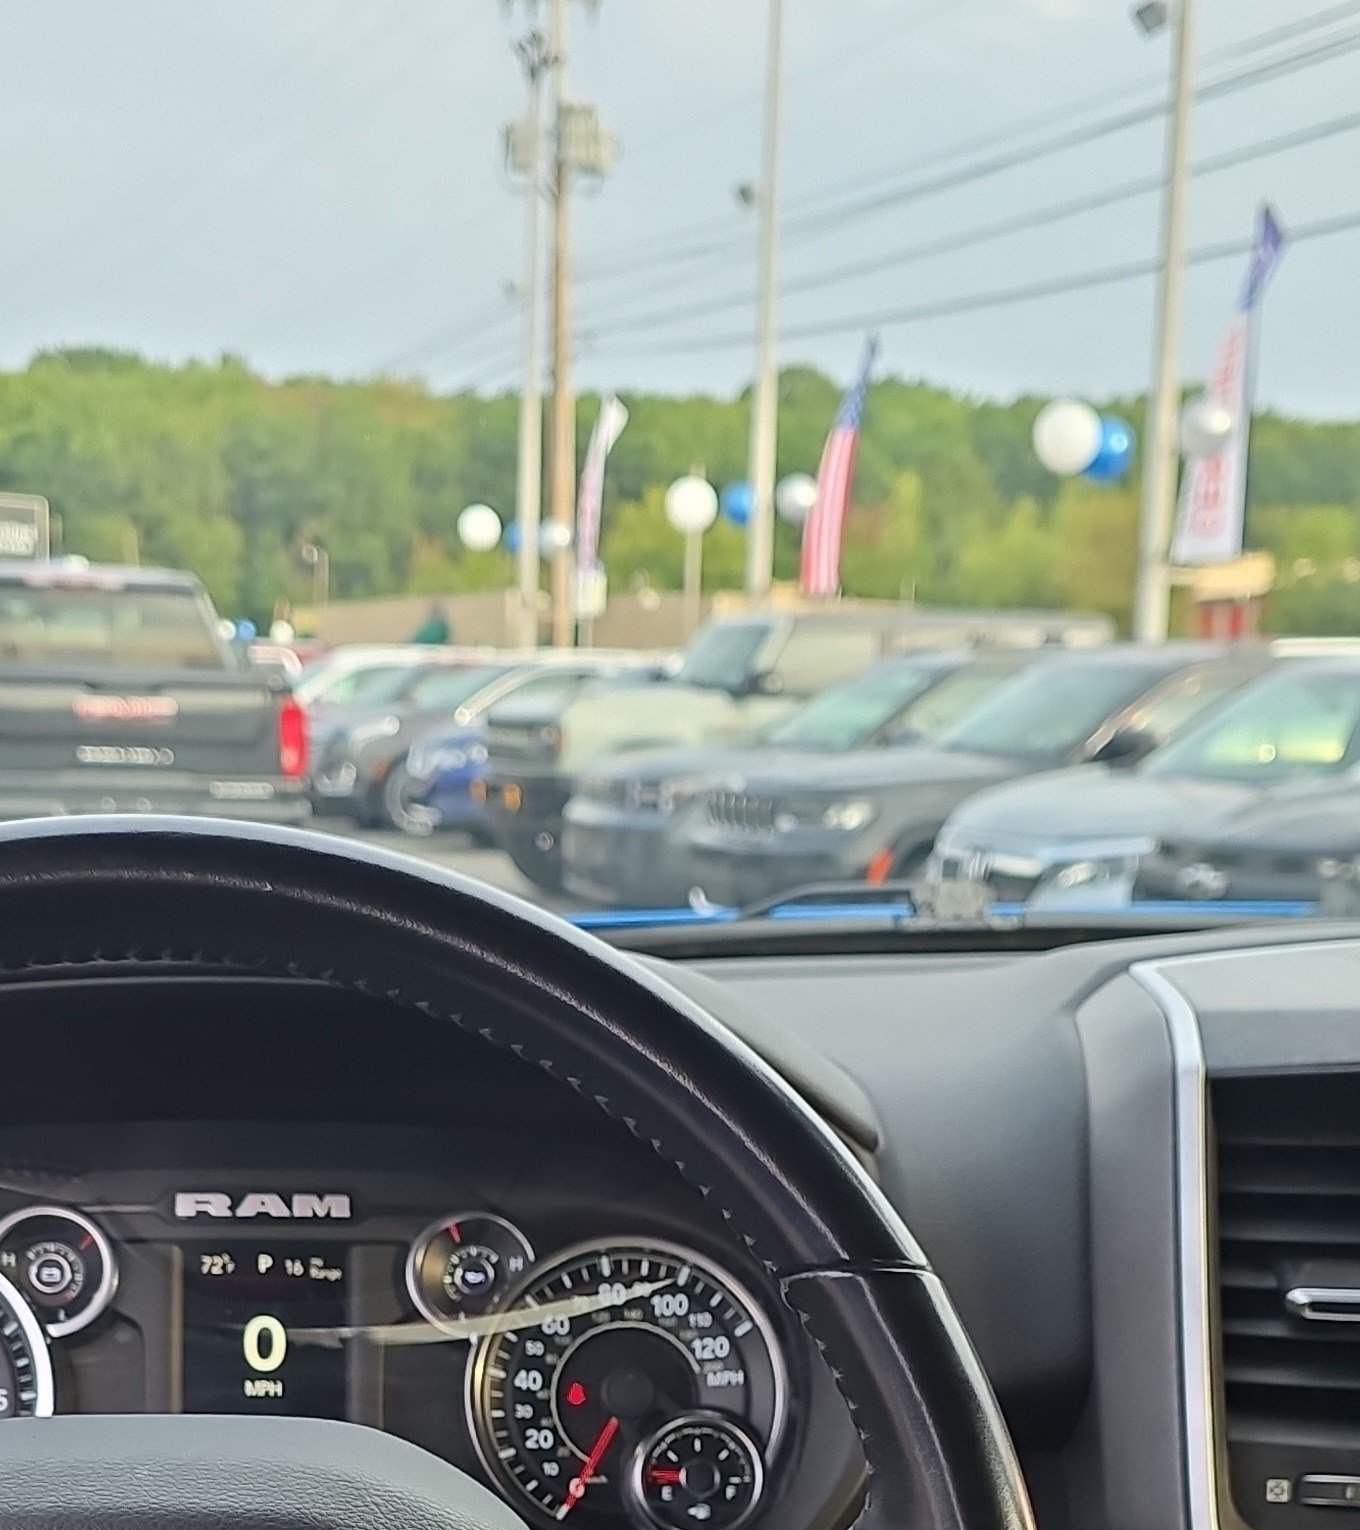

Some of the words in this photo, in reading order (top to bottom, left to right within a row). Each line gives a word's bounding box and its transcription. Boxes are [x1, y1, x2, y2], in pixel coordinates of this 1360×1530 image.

[174, 1192, 352, 1218] RAM
[257, 1253, 274, 1274] P
[598, 1282, 626, 1306] 80
[650, 1292, 690, 1317] 100
[541, 1313, 570, 1336] 60
[242, 1314, 288, 1373] 0
[690, 1335, 731, 1361] 120
[243, 1379, 284, 1398] MPH
[513, 1369, 543, 1392] 40
[706, 1369, 745, 1388] MPH
[524, 1427, 555, 1450] 20
